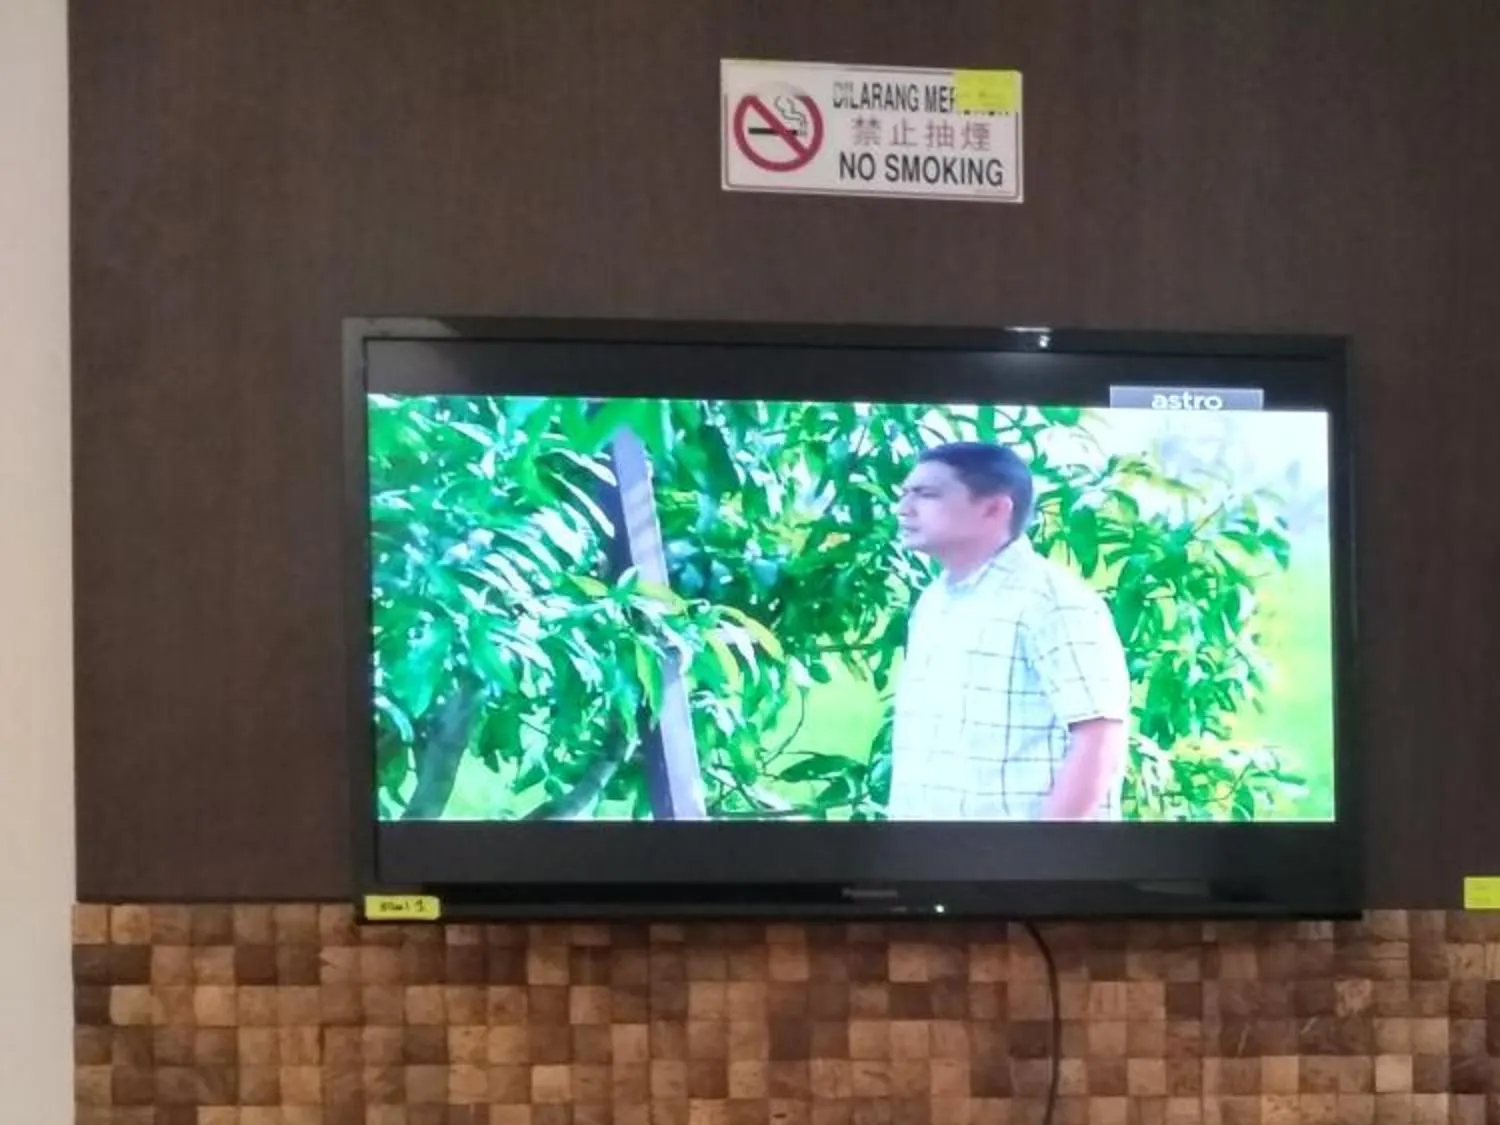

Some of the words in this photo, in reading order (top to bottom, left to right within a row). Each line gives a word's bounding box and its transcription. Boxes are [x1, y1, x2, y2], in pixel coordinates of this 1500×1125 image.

[832, 82, 919, 112] DILARANG
[851, 116, 991, 151] 禁止抽煙
[839, 153, 875, 181] NO
[885, 154, 1004, 187] SMOKING
[1151, 391, 1224, 411] astro
